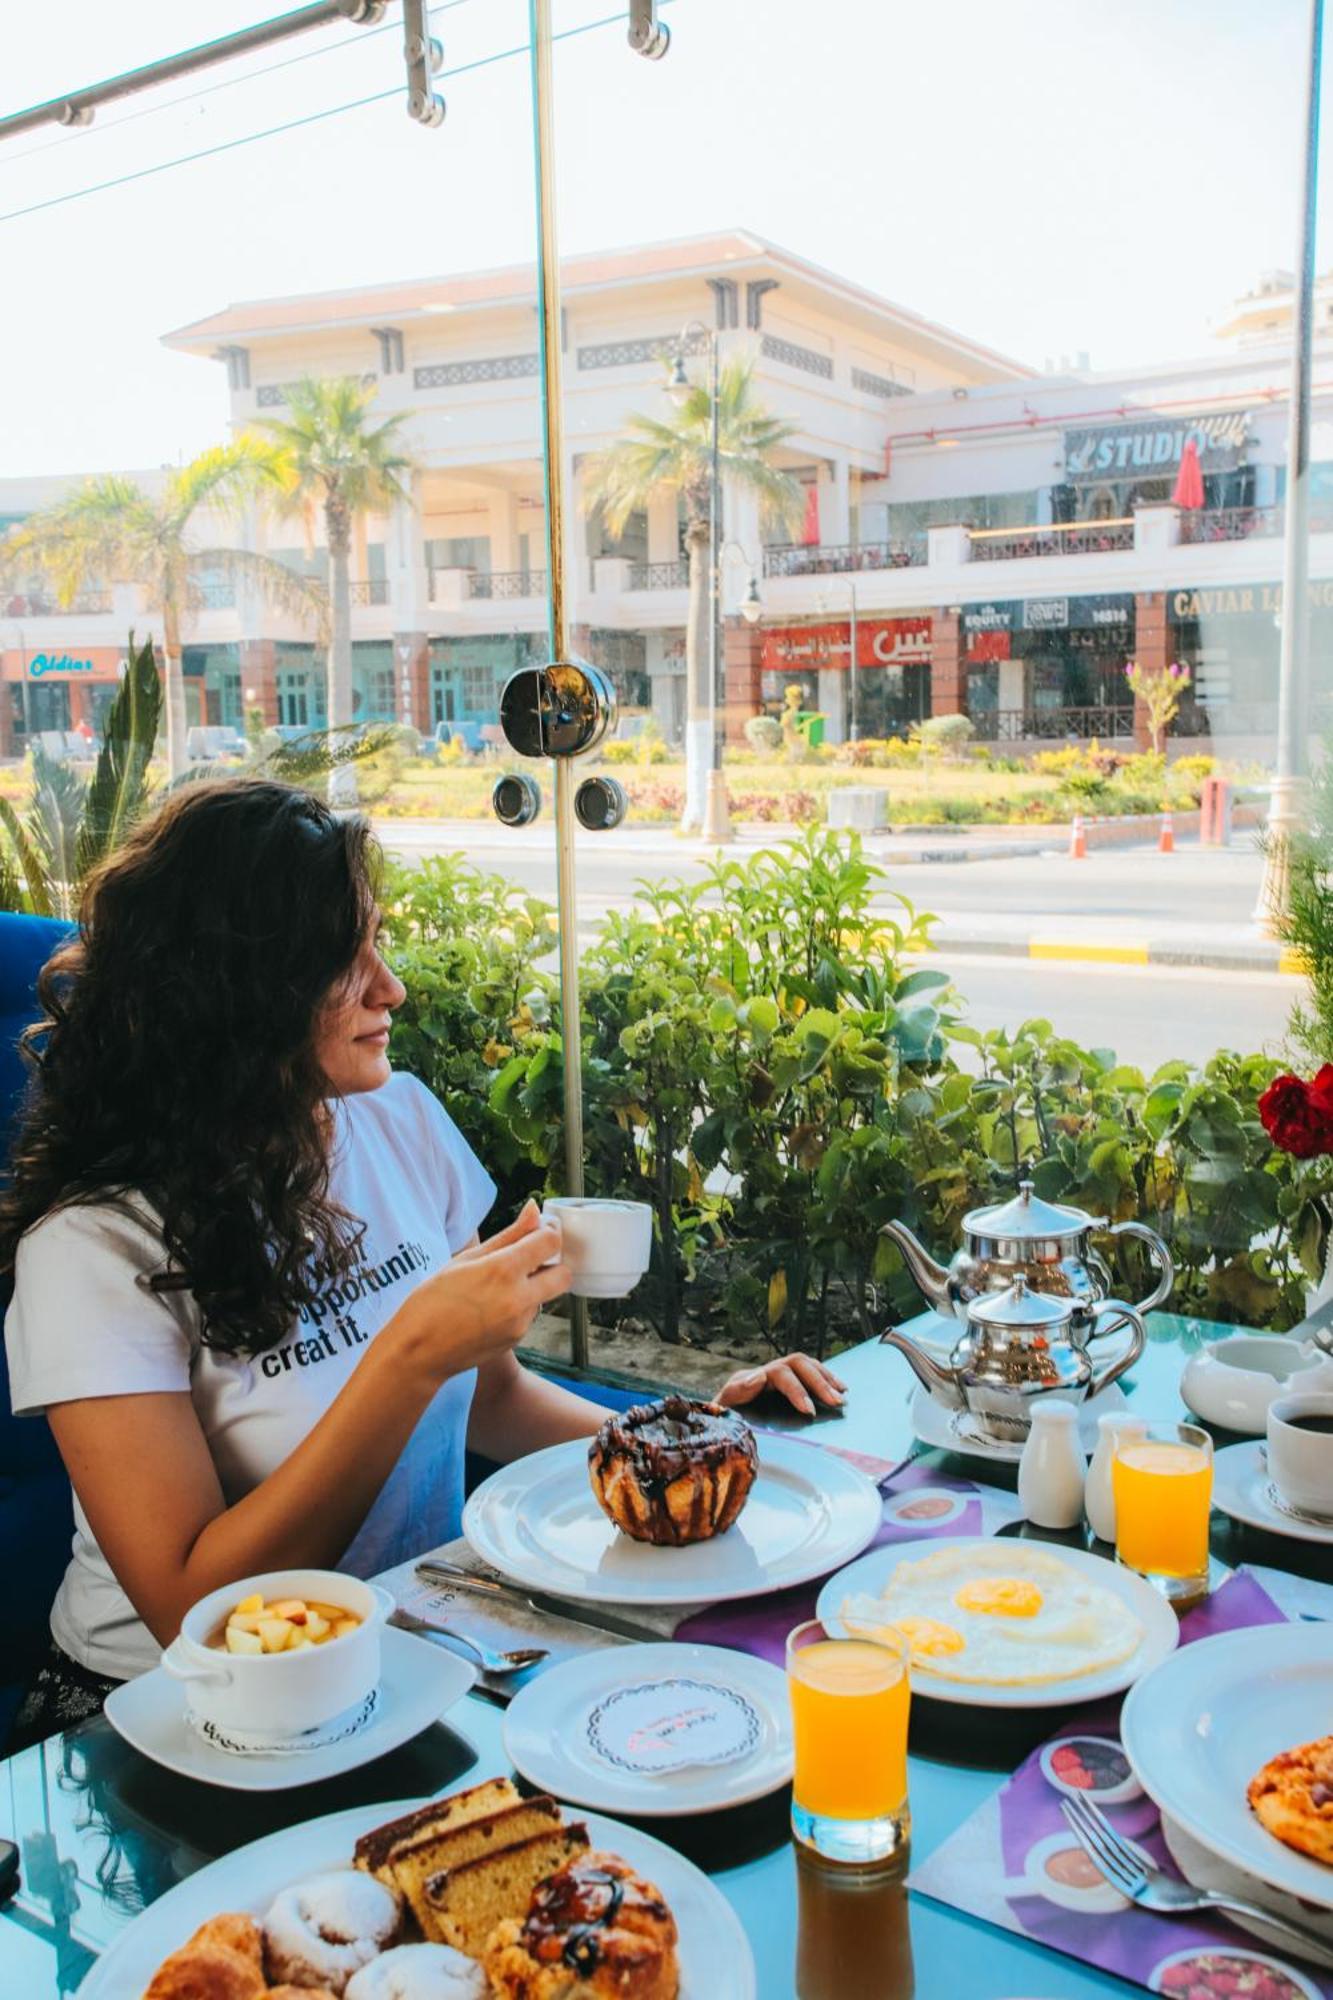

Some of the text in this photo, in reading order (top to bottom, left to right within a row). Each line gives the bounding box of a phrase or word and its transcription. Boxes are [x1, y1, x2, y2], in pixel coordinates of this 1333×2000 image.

[1096, 430, 1206, 469] STUDIO
[1174, 589, 1254, 616] CAVIAR
[965, 612, 1011, 627] EQUITY
[261, 1315, 368, 1379] creat it.
